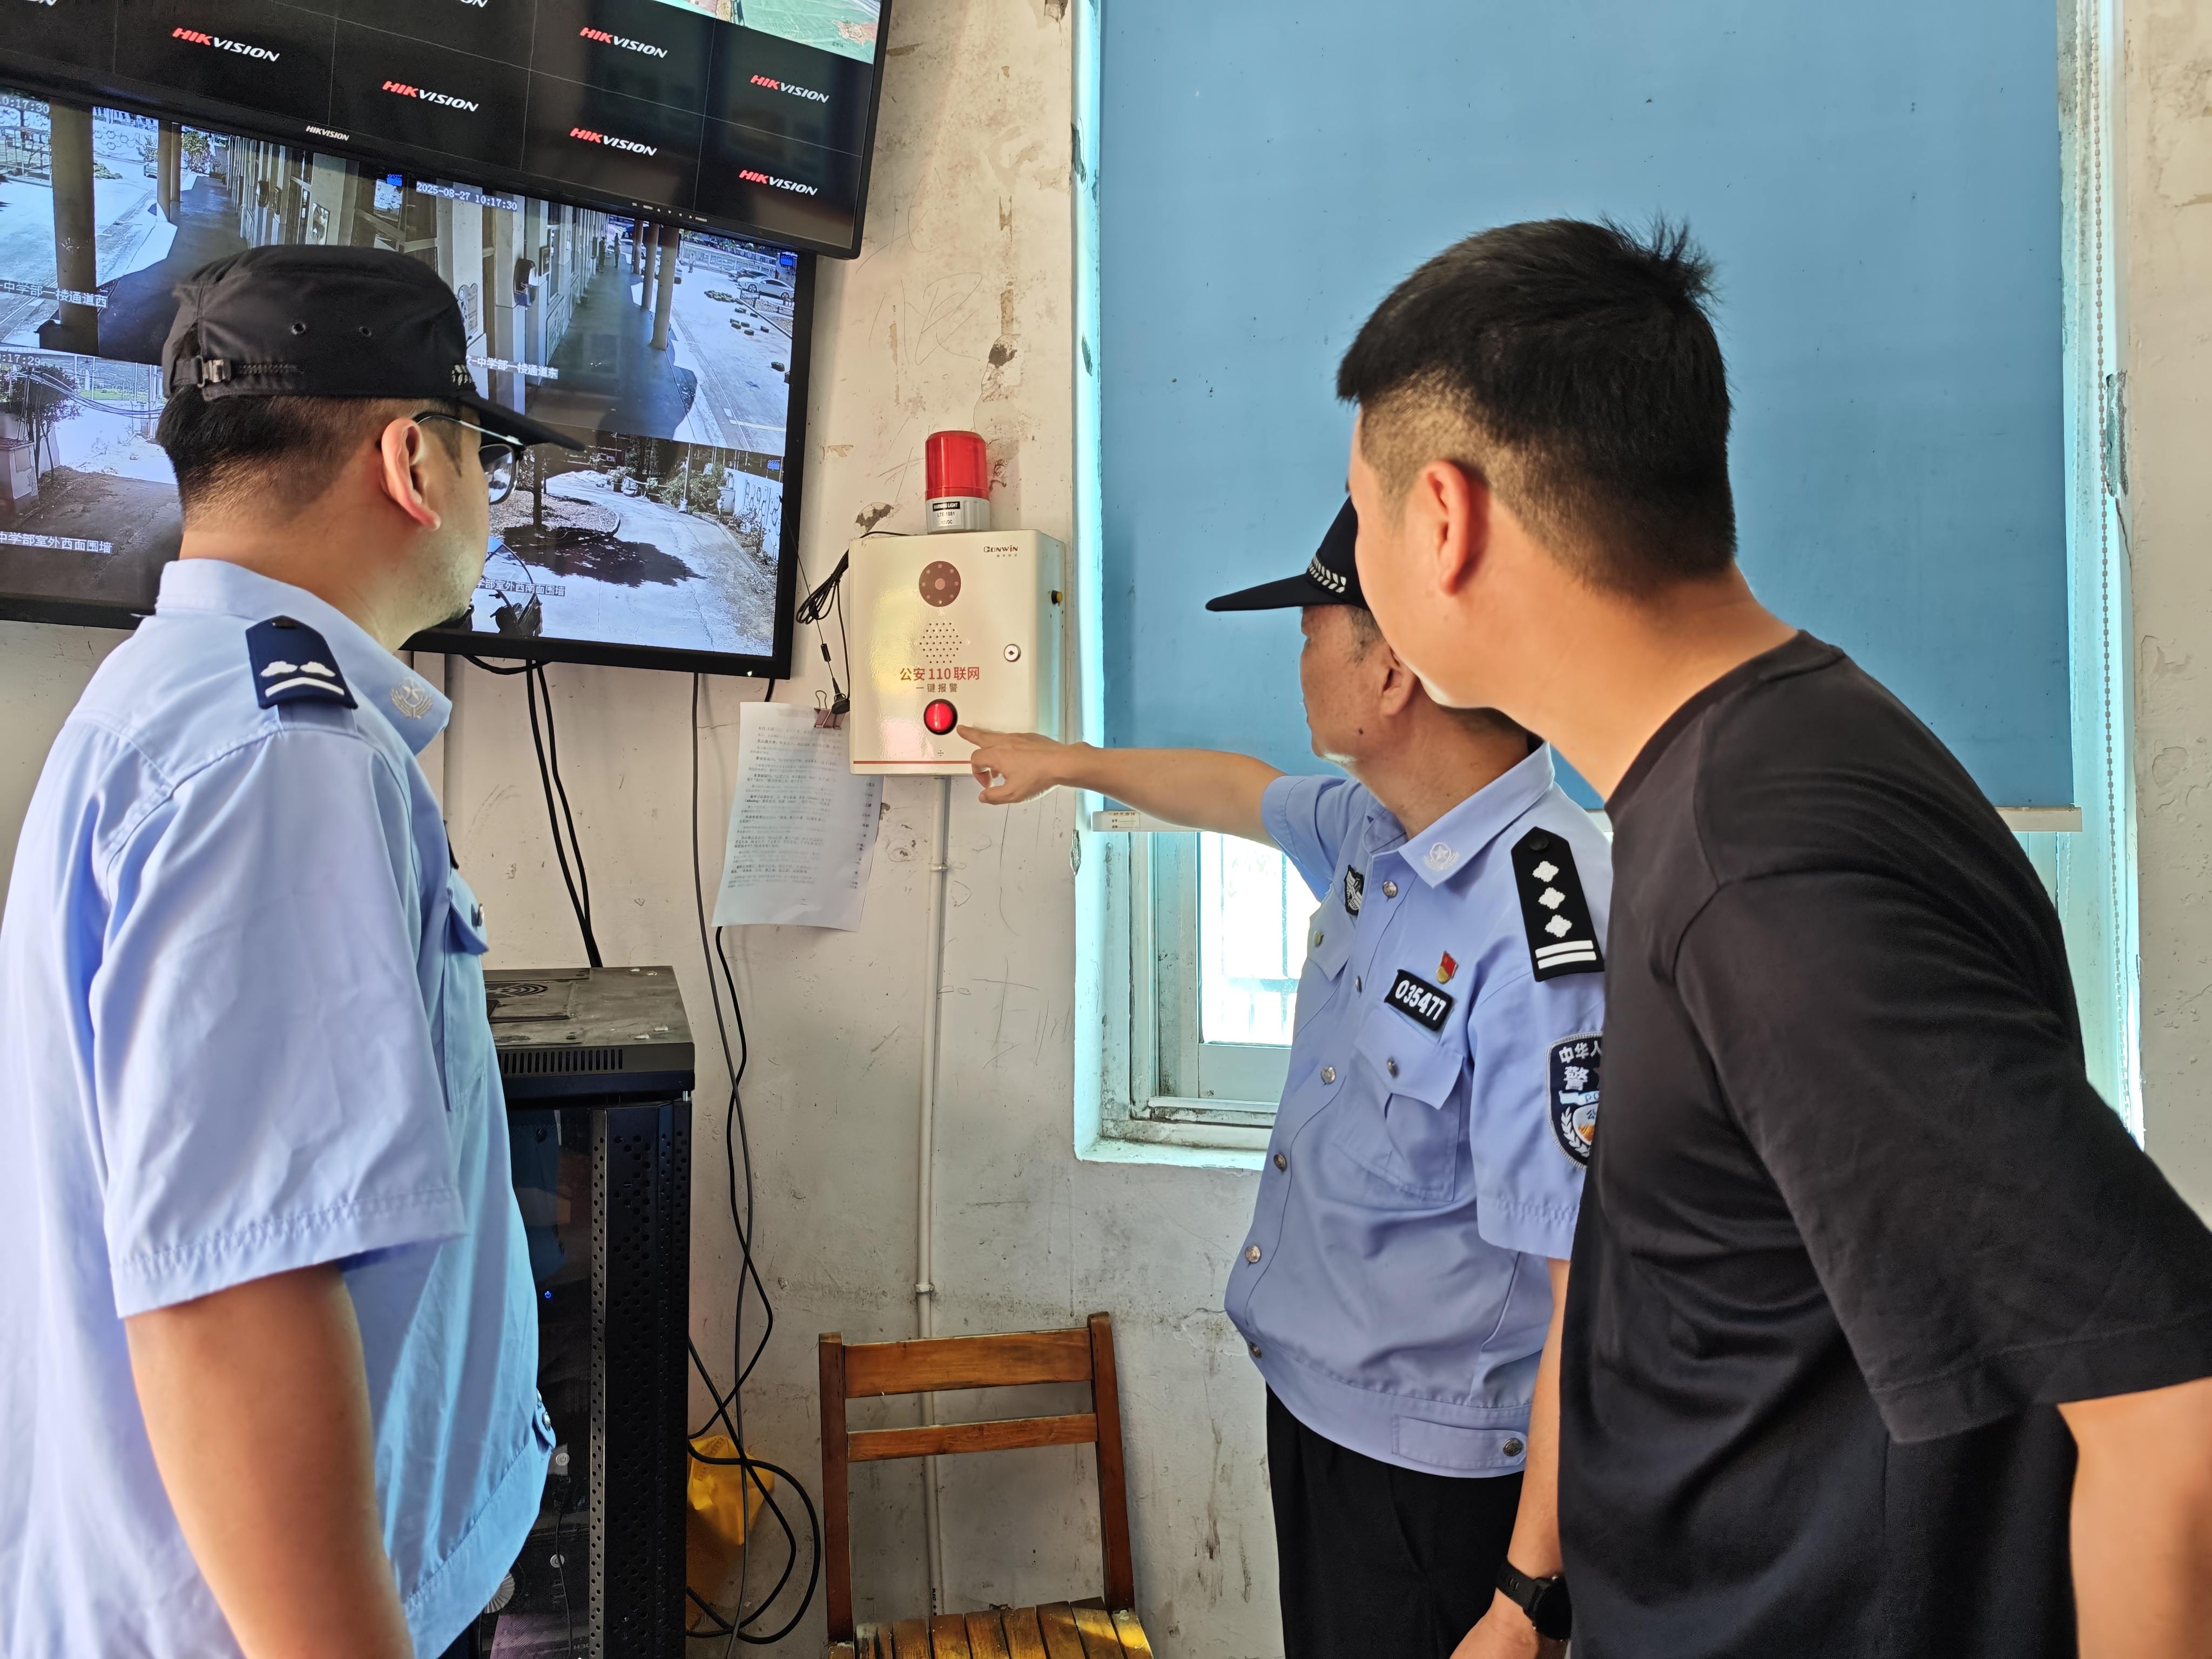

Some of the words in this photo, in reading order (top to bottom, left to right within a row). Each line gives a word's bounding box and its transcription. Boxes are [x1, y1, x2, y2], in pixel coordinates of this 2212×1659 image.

[172, 28, 280, 62] HIKVISION
[579, 27, 668, 58] HIKVISION
[382, 80, 479, 112] HIKVISION
[750, 75, 830, 103] HIKVISION
[0, 96, 50, 114] 0:17:30
[306, 125, 350, 141] HIKVISION
[570, 127, 657, 156] HIKVISION
[416, 183, 471, 201] 2025-08-27
[475, 194, 517, 211] 10:17:30
[739, 170, 818, 196] HIKVISION
[0, 353, 41, 366] :17:29
[900, 666, 980, 681] 公安110联网
[916, 683, 958, 692] 一键报警
[1395, 980, 1447, 1021] 035477
